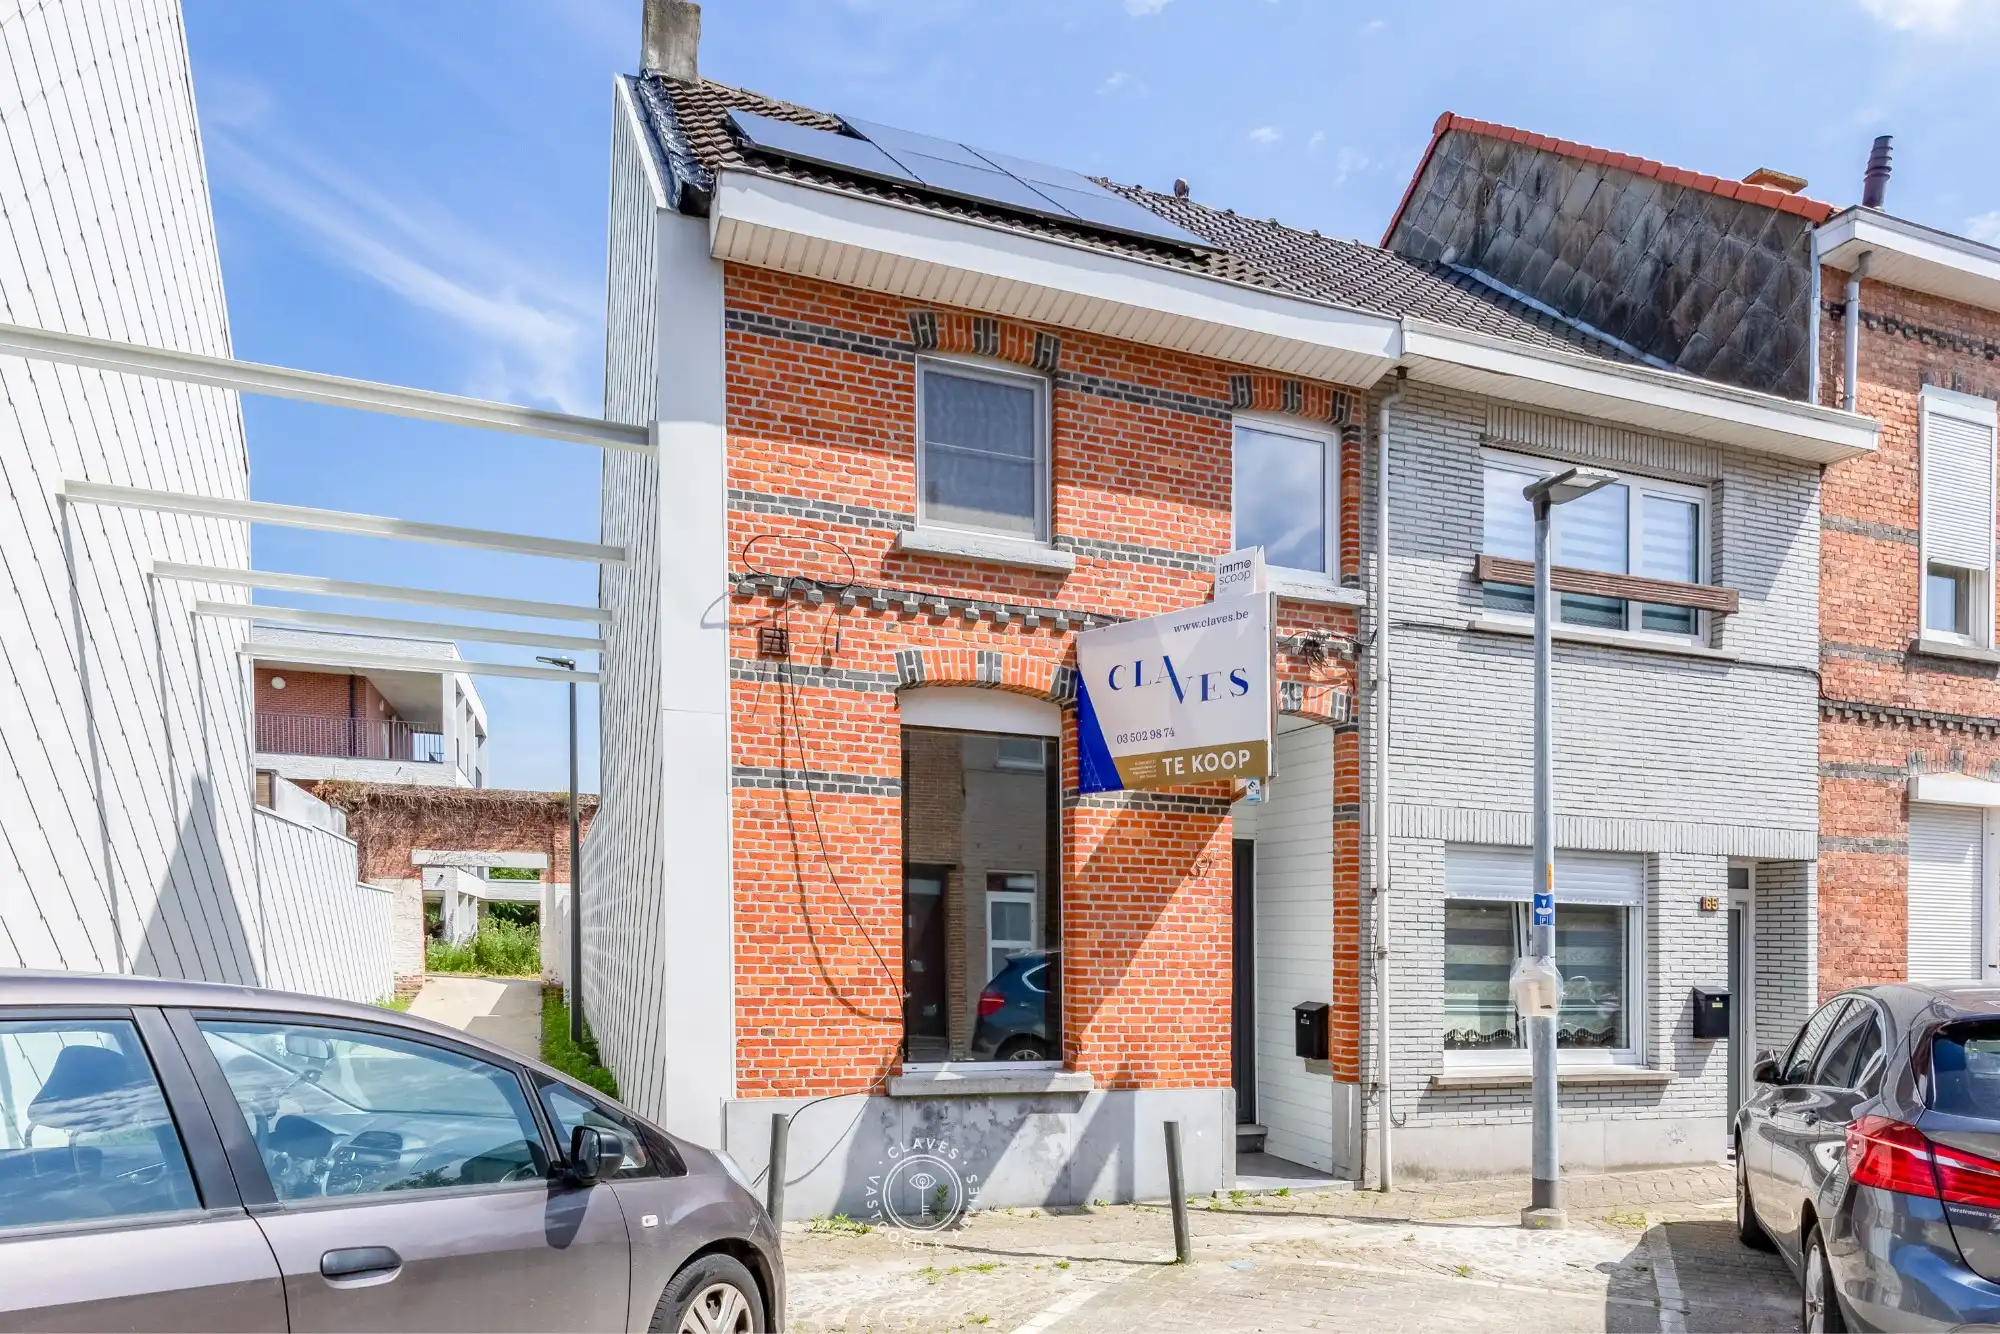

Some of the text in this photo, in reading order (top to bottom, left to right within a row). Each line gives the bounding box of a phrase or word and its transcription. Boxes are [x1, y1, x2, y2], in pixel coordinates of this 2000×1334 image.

[1219, 560, 1252, 575] immo
[1219, 570, 1251, 585] scoop
[1173, 610, 1249, 633] www.claves.be
[1108, 655, 1250, 705] CLAVES
[1116, 726, 1176, 745] 03 502 98 74
[1162, 756, 1185, 776] TE
[1191, 749, 1251, 774] KOOP
